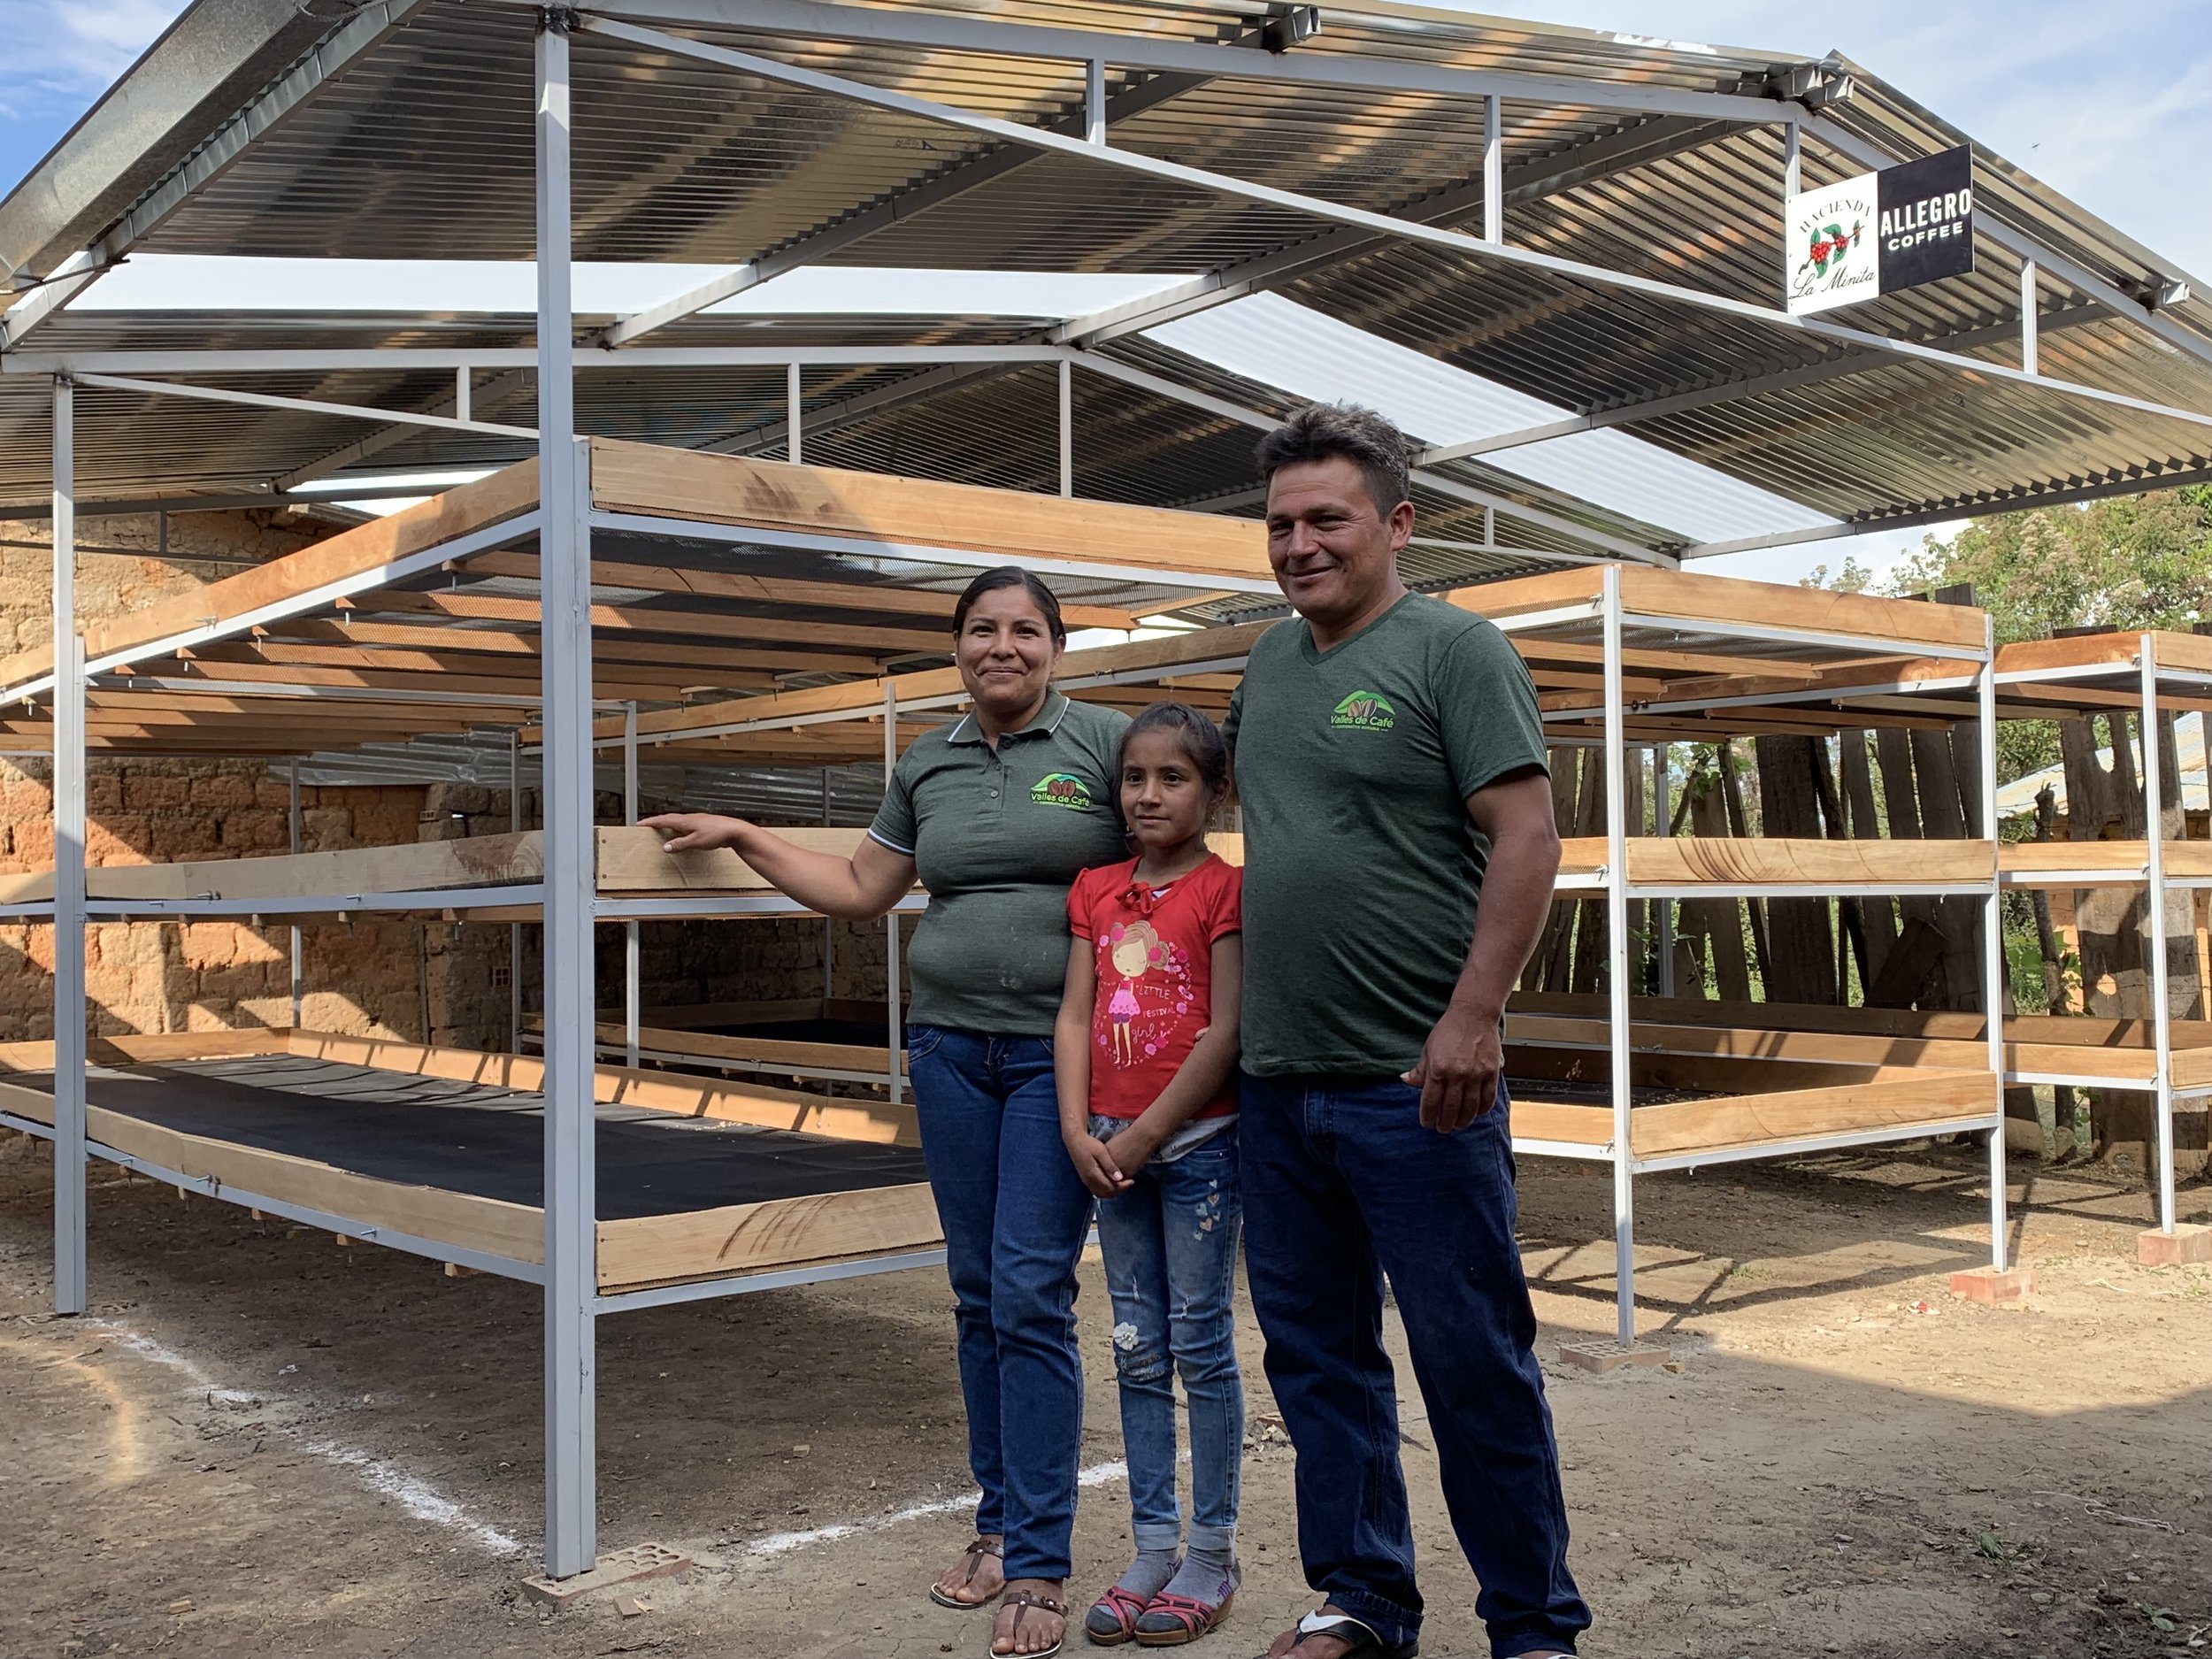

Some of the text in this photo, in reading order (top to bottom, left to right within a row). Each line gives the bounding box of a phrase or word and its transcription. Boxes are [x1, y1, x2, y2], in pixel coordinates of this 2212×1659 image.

[1800, 199, 1870, 234] HACIENDA
[1880, 188, 1971, 237] ALLEGRO
[1888, 221, 1963, 251] COFFEE
[1788, 265, 1876, 299] La Minita
[1355, 716, 1368, 725] de
[1370, 717, 1394, 727] Café
[1031, 793, 1056, 802] Valles
[1057, 795, 1070, 803] de
[1071, 796, 1090, 806] Café
[1139, 985, 1170, 999] LITTLE
[1143, 1007, 1176, 1018] FESTIVAL
[1132, 1023, 1156, 1043] girl
